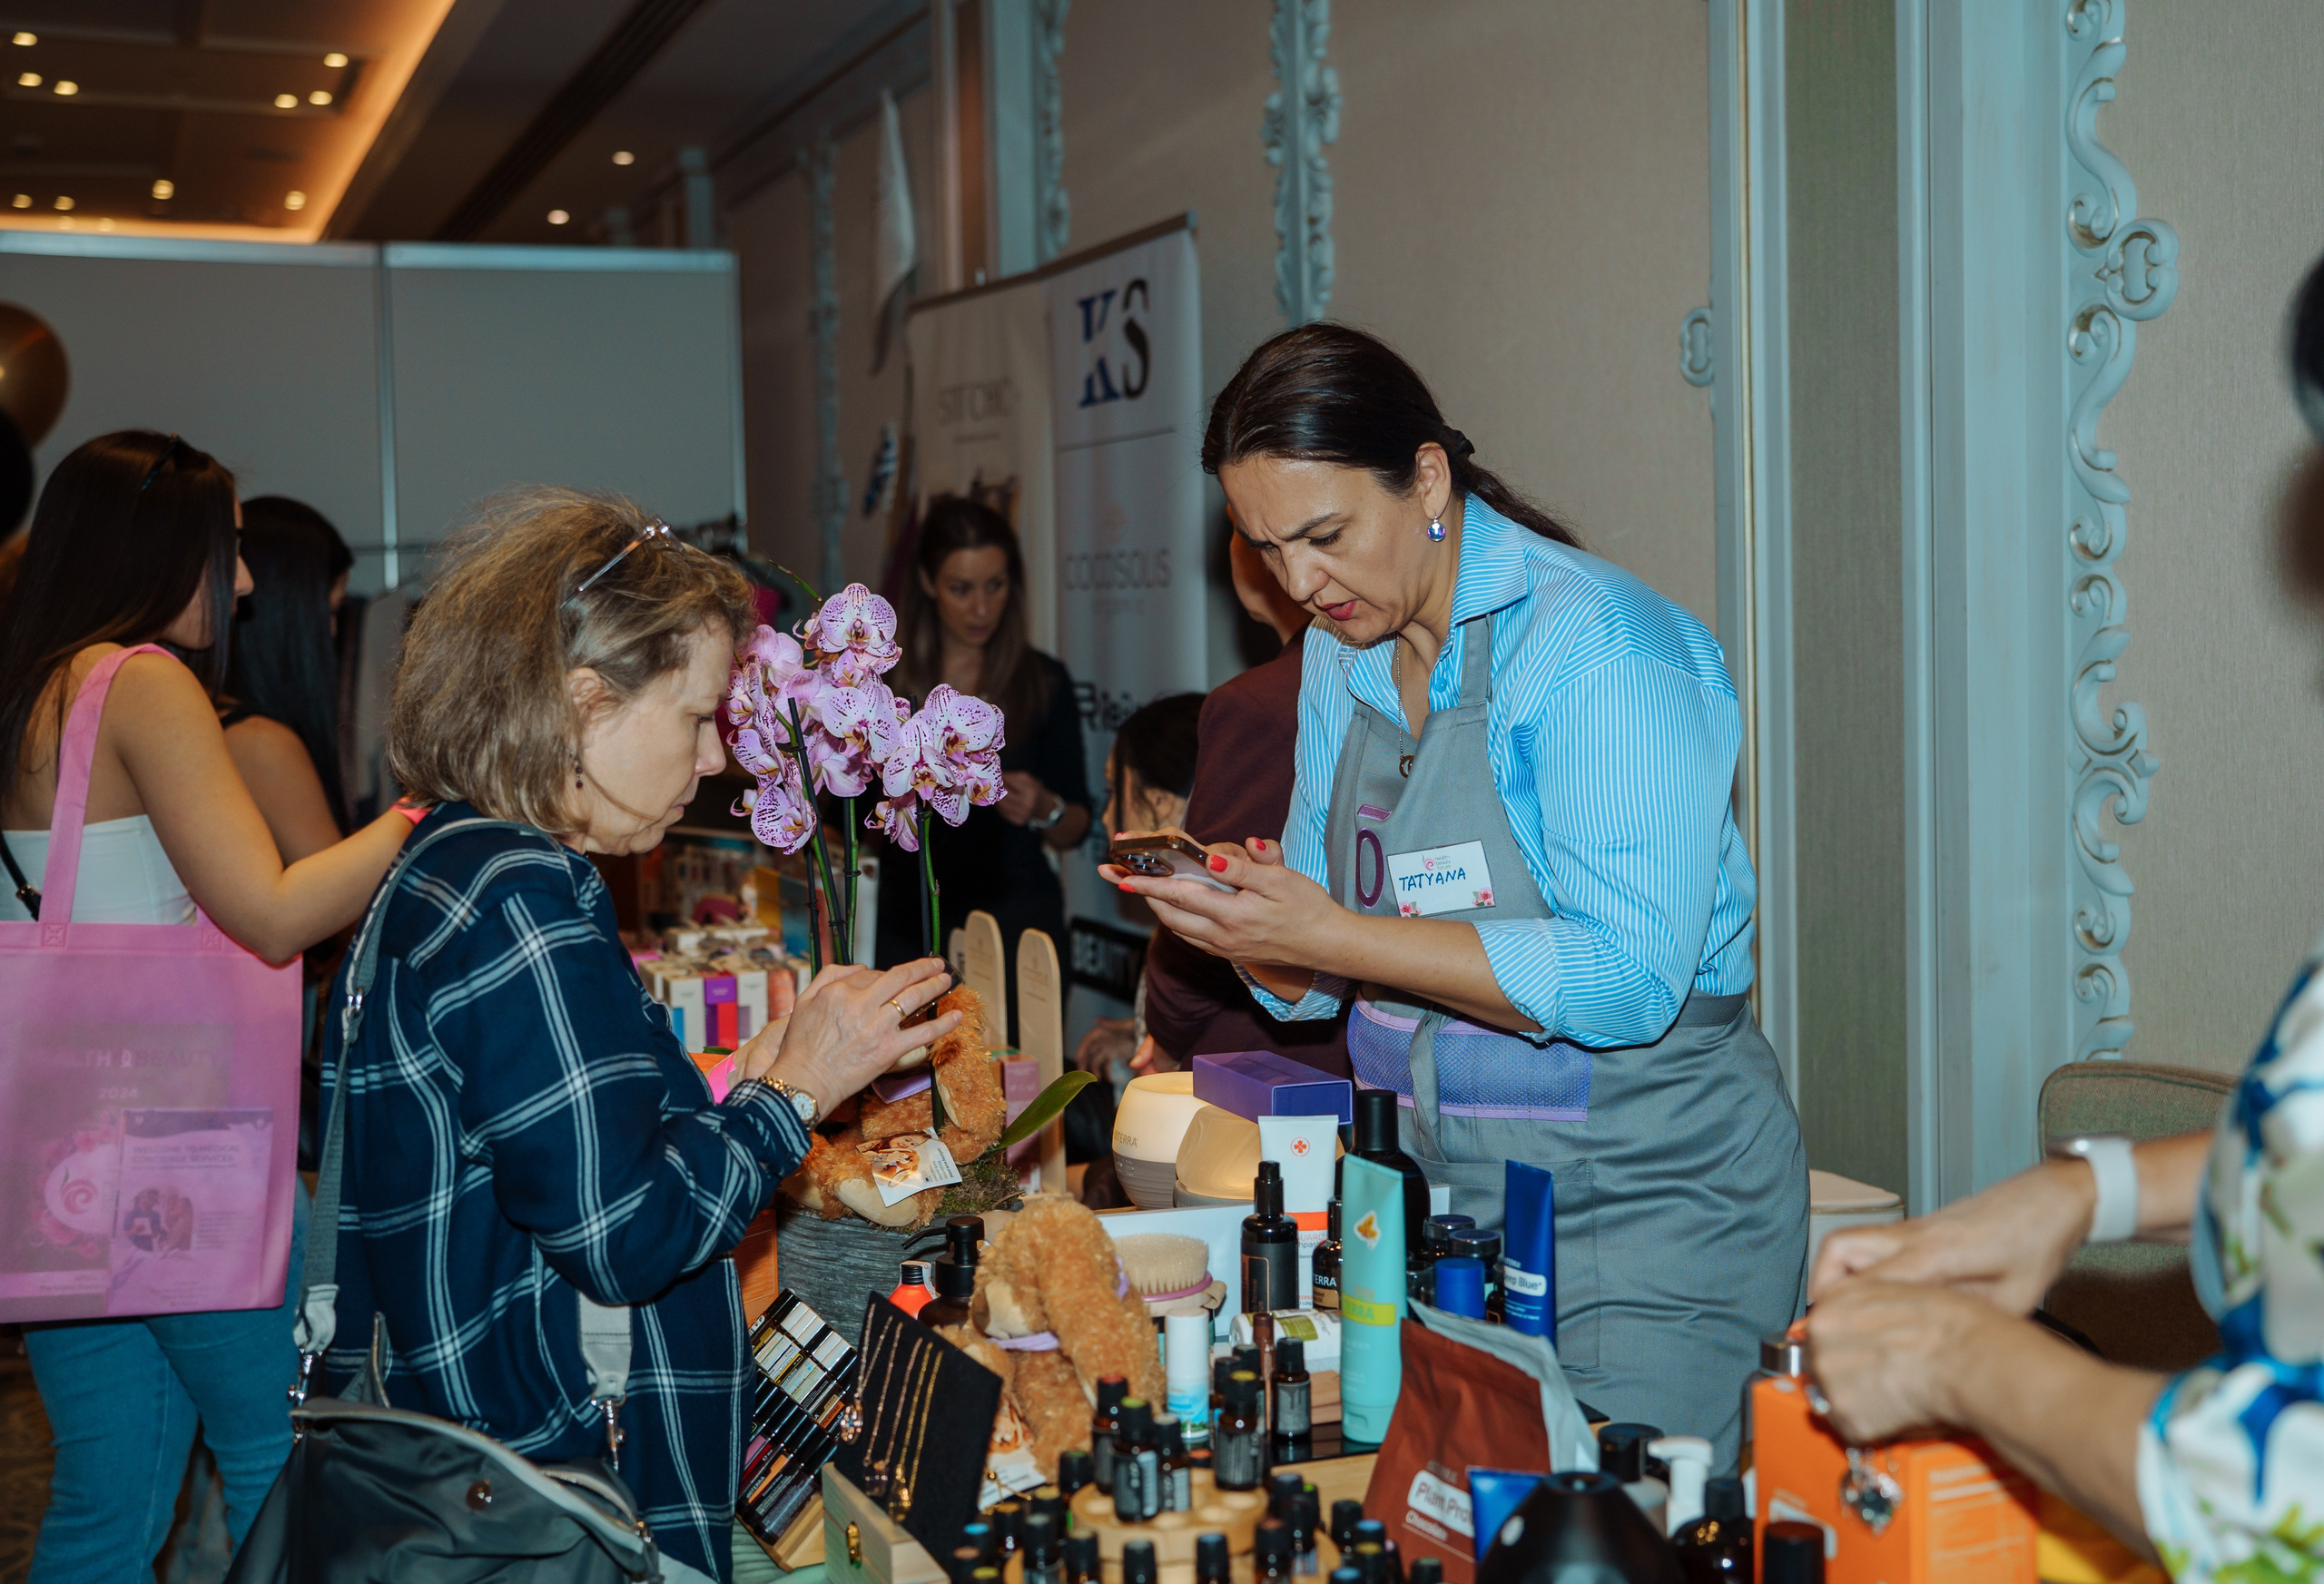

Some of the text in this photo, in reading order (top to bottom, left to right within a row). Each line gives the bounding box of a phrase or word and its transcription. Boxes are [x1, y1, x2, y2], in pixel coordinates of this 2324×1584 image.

[1077, 278, 1150, 408] KS
[1399, 867, 1466, 891] TATYANA
[1313, 1274, 1337, 1287] ERRA
